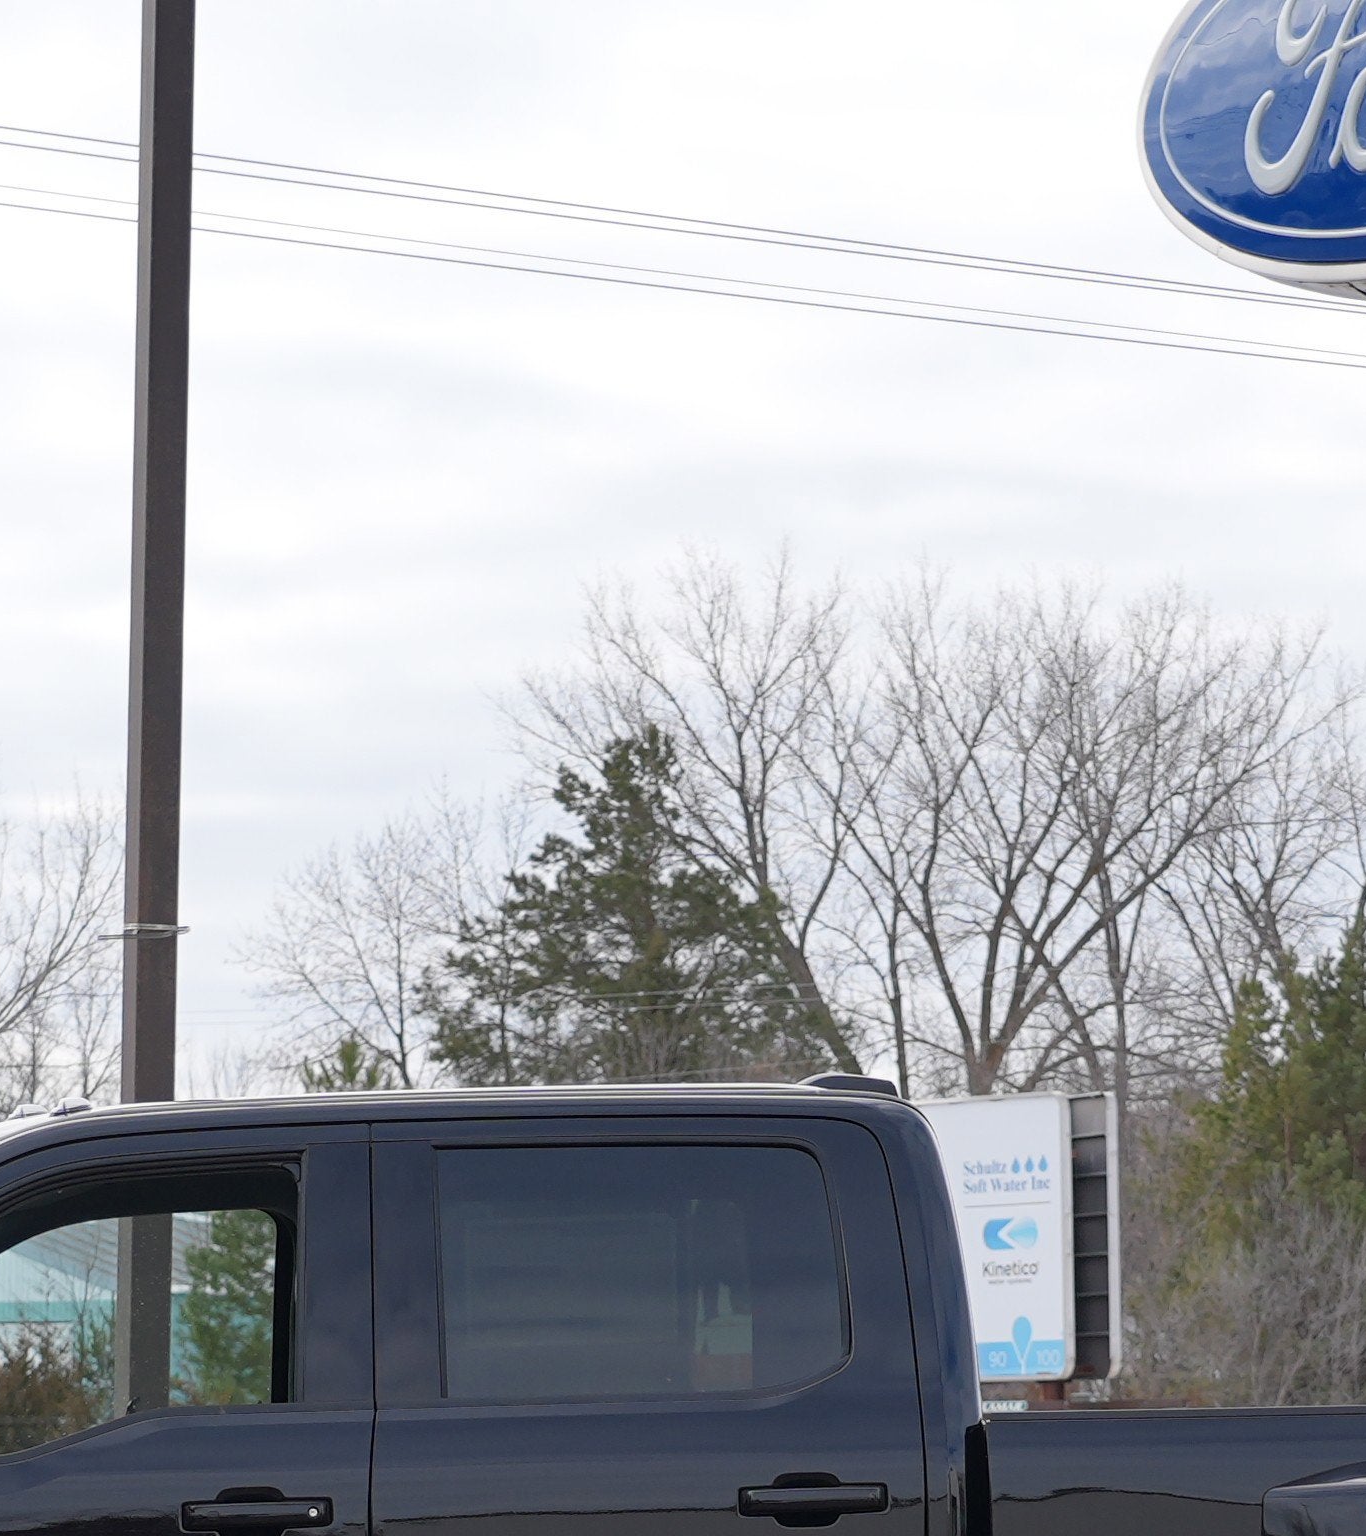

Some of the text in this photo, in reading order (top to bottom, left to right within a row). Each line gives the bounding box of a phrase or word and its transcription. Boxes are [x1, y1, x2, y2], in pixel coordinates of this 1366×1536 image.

[963, 1175, 1050, 1193] Soft Water Inc
[982, 1260, 1038, 1277] Kinetico
[988, 1348, 1061, 1368] 90 100
